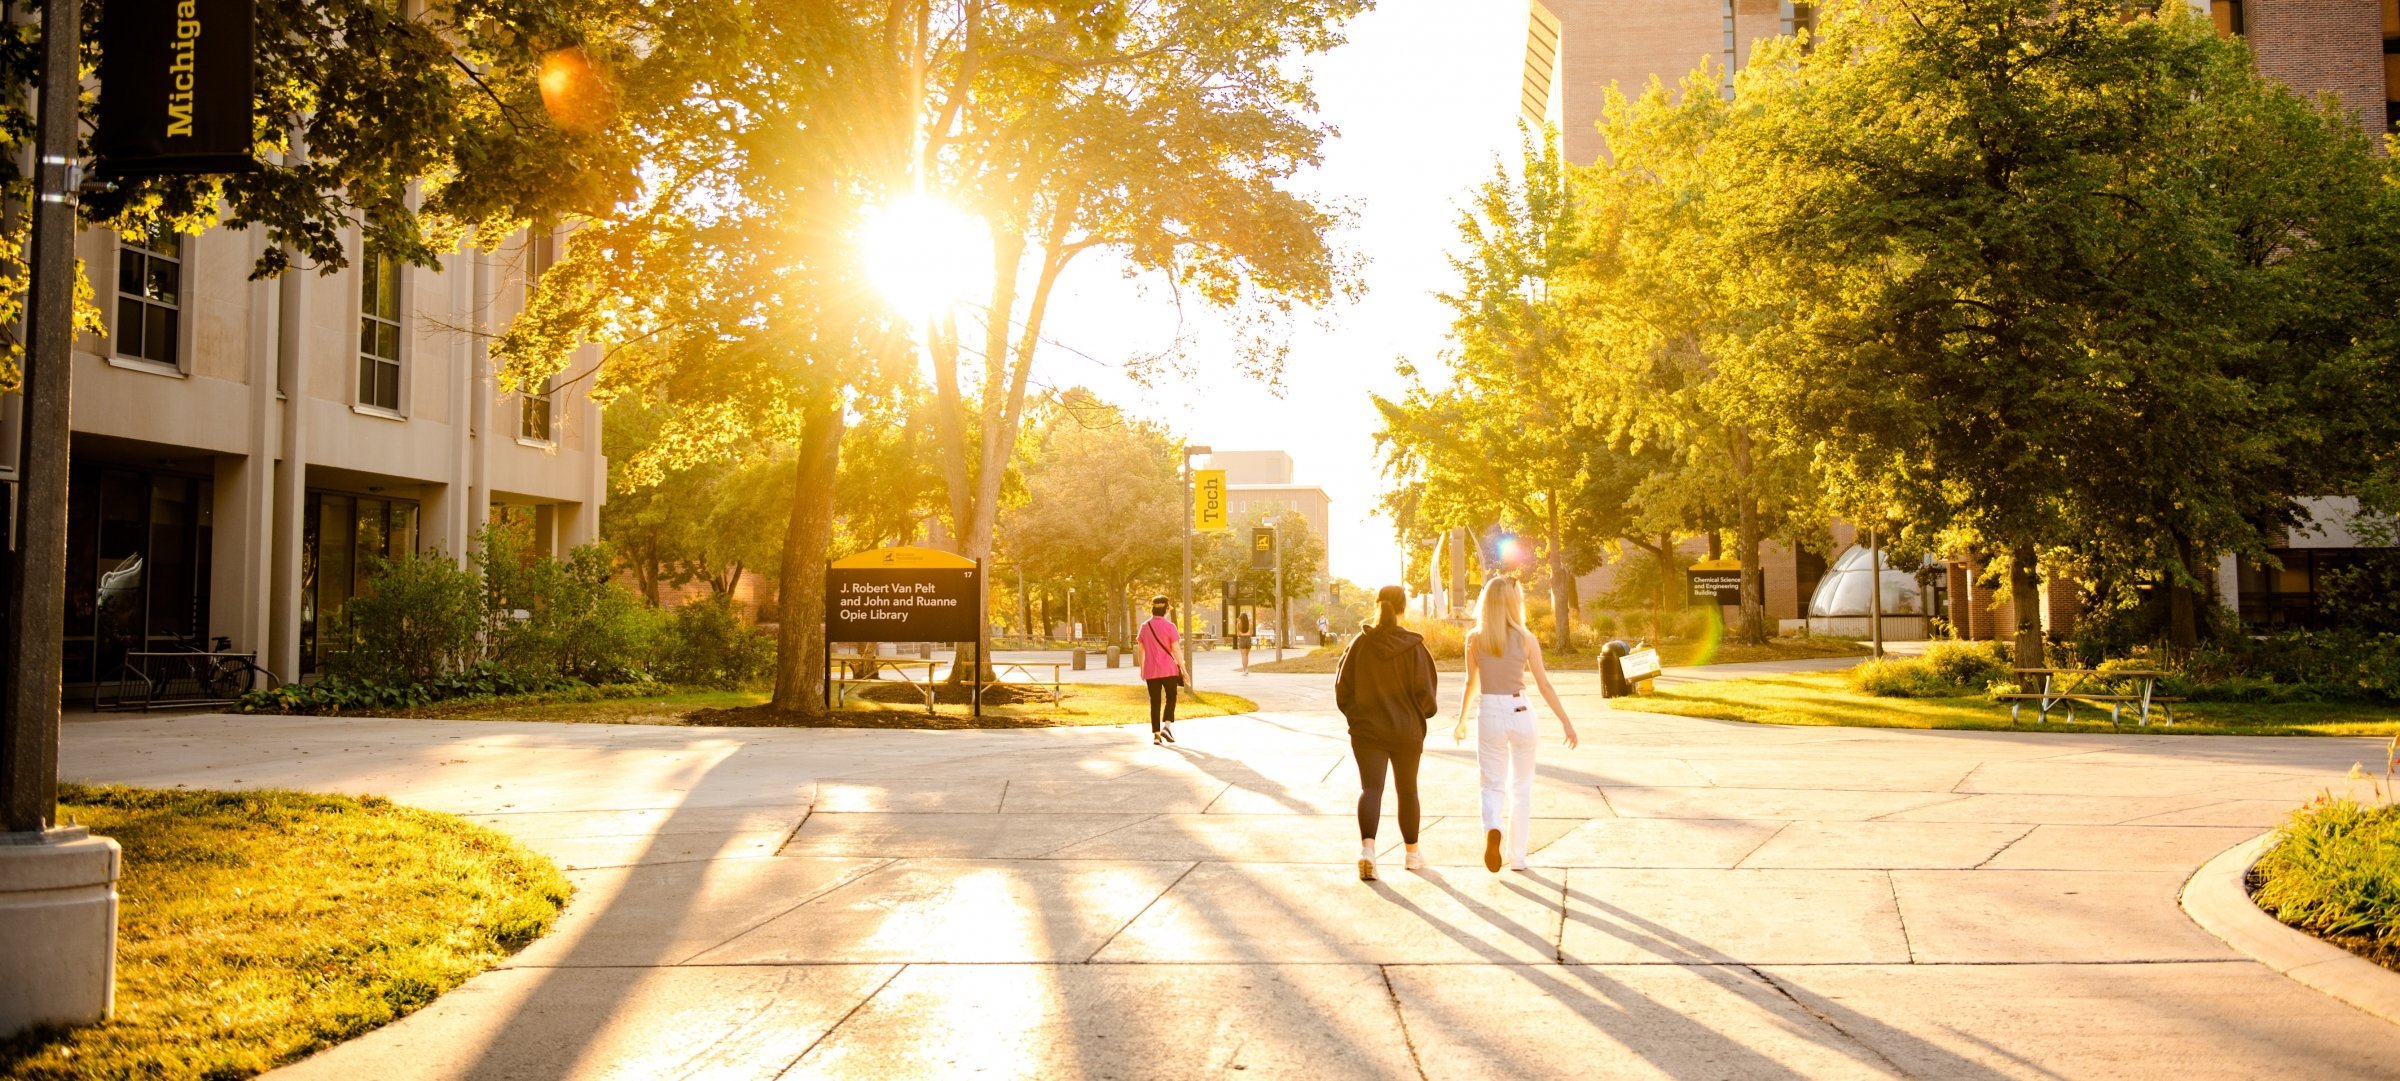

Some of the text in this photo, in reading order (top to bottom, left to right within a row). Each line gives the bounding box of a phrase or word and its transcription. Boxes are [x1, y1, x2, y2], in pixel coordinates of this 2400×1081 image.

[1203, 478, 1218, 522] Tech
[840, 583, 936, 593] J. Robert Van Pelt
[840, 596, 957, 606] and John and Ruanne
[840, 609, 908, 622] Opie Library
